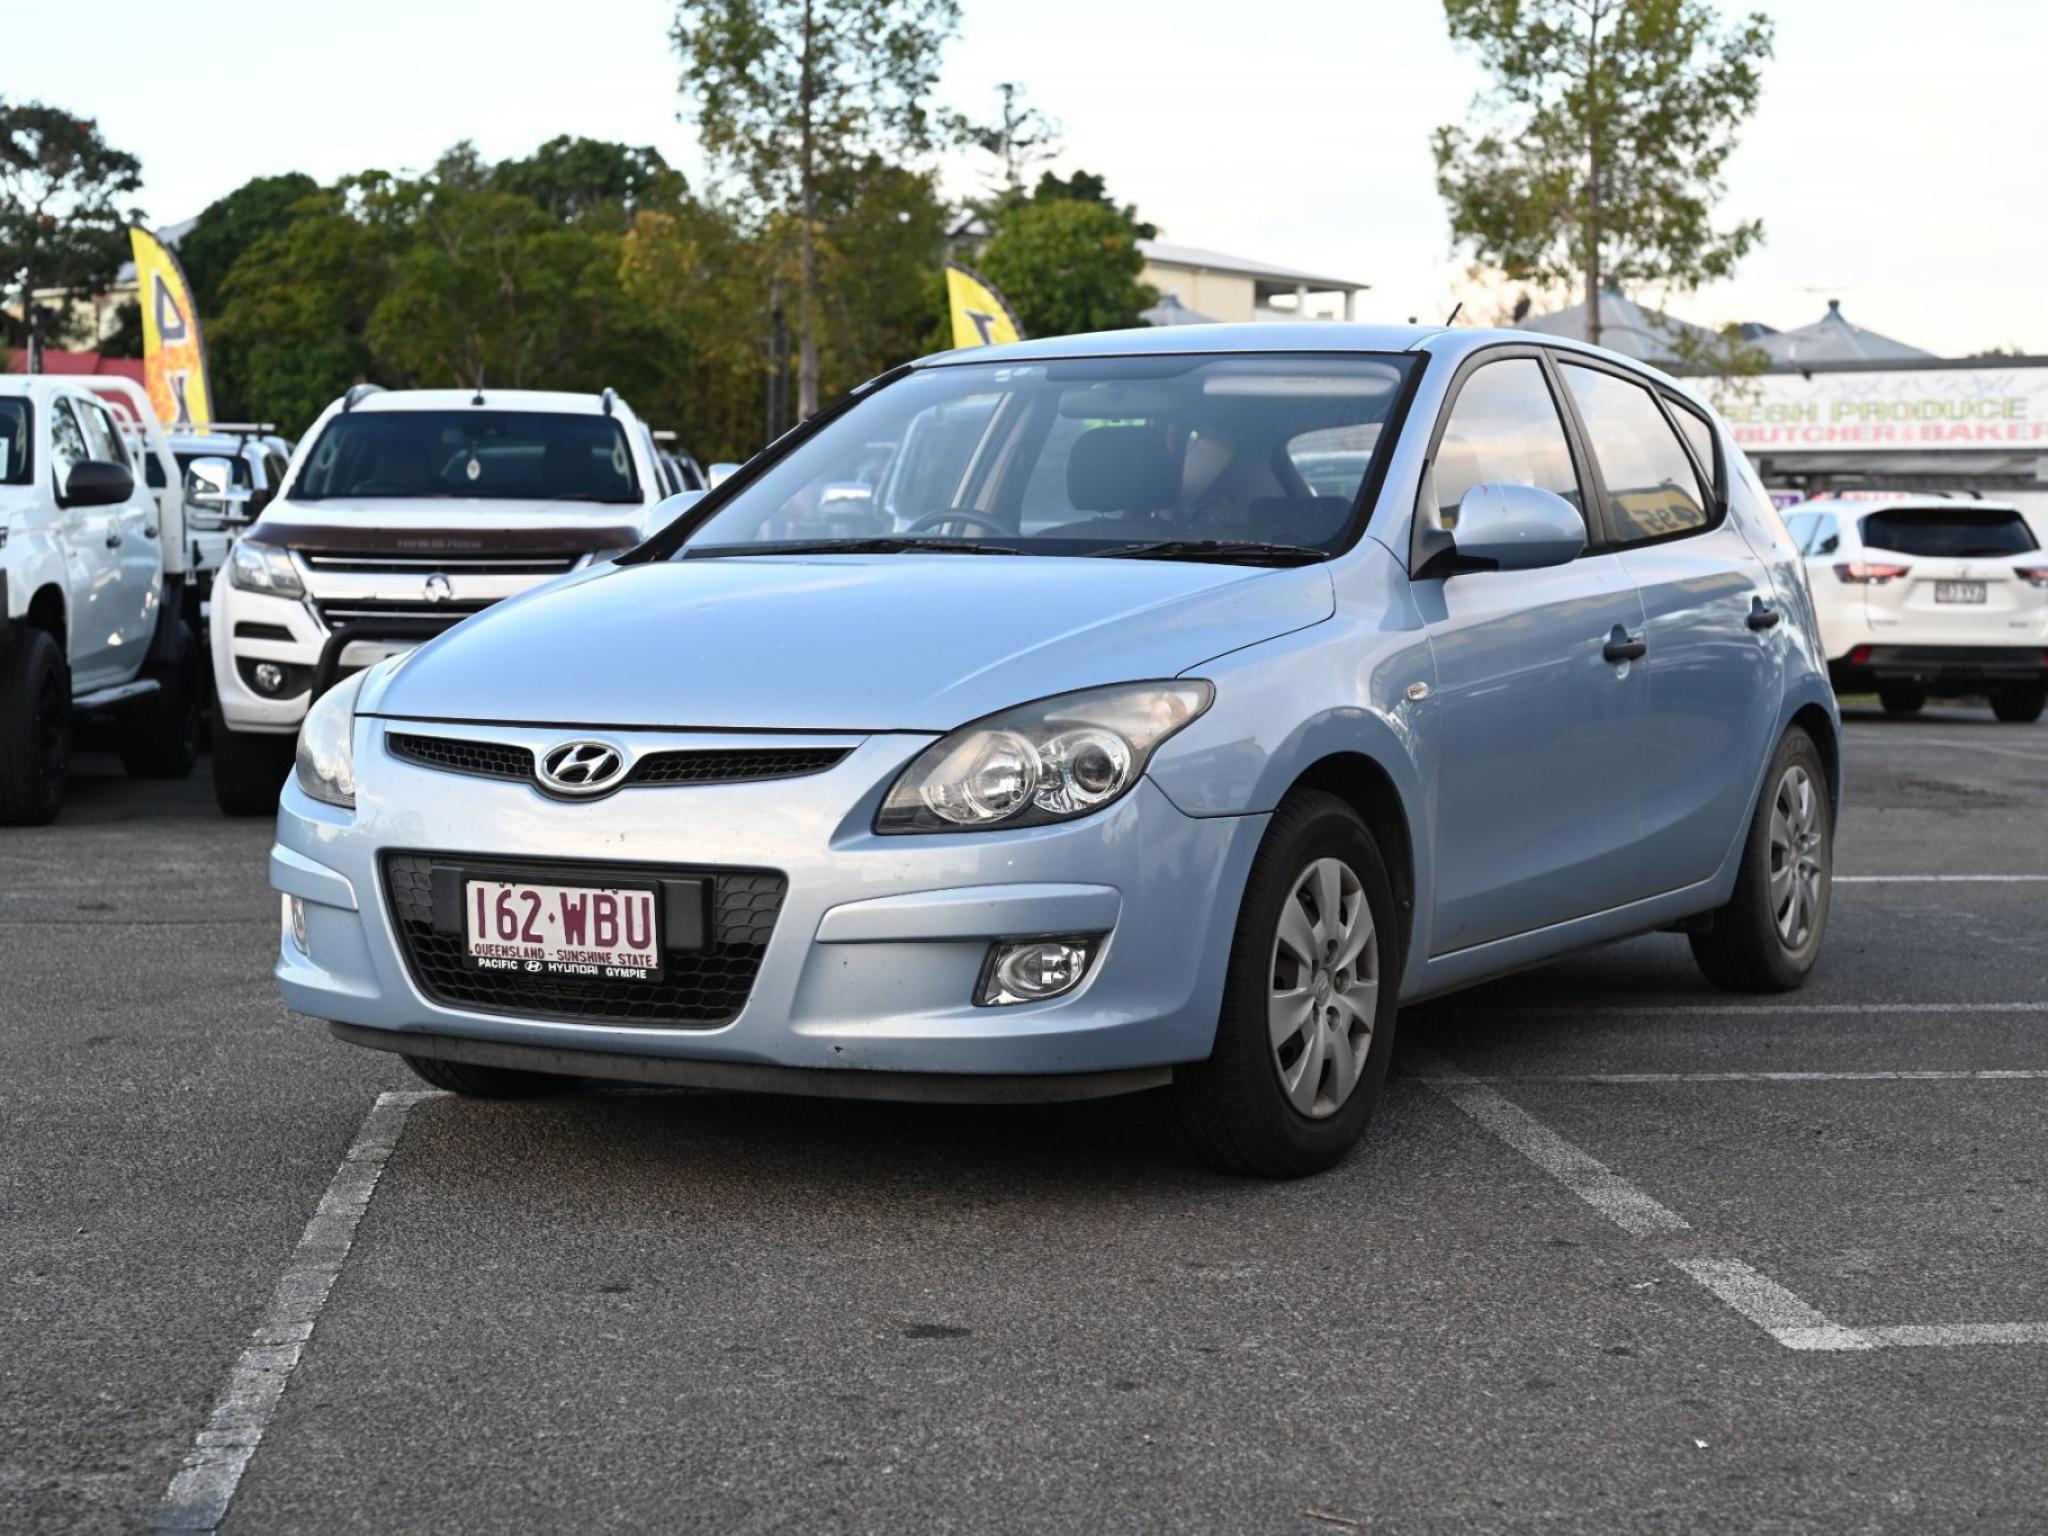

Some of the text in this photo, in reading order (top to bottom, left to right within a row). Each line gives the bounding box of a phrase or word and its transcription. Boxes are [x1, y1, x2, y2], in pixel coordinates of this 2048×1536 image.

[1831, 397, 2027, 422] PRODUCE
[1732, 424, 1895, 442] BUTCHER
[474, 943, 545, 959] QUEENSLAND
[556, 949, 613, 964] SUNSHINE
[618, 953, 653, 968] STATE
[478, 958, 647, 979] PACIFIC HYUNDAI GYMPIE
